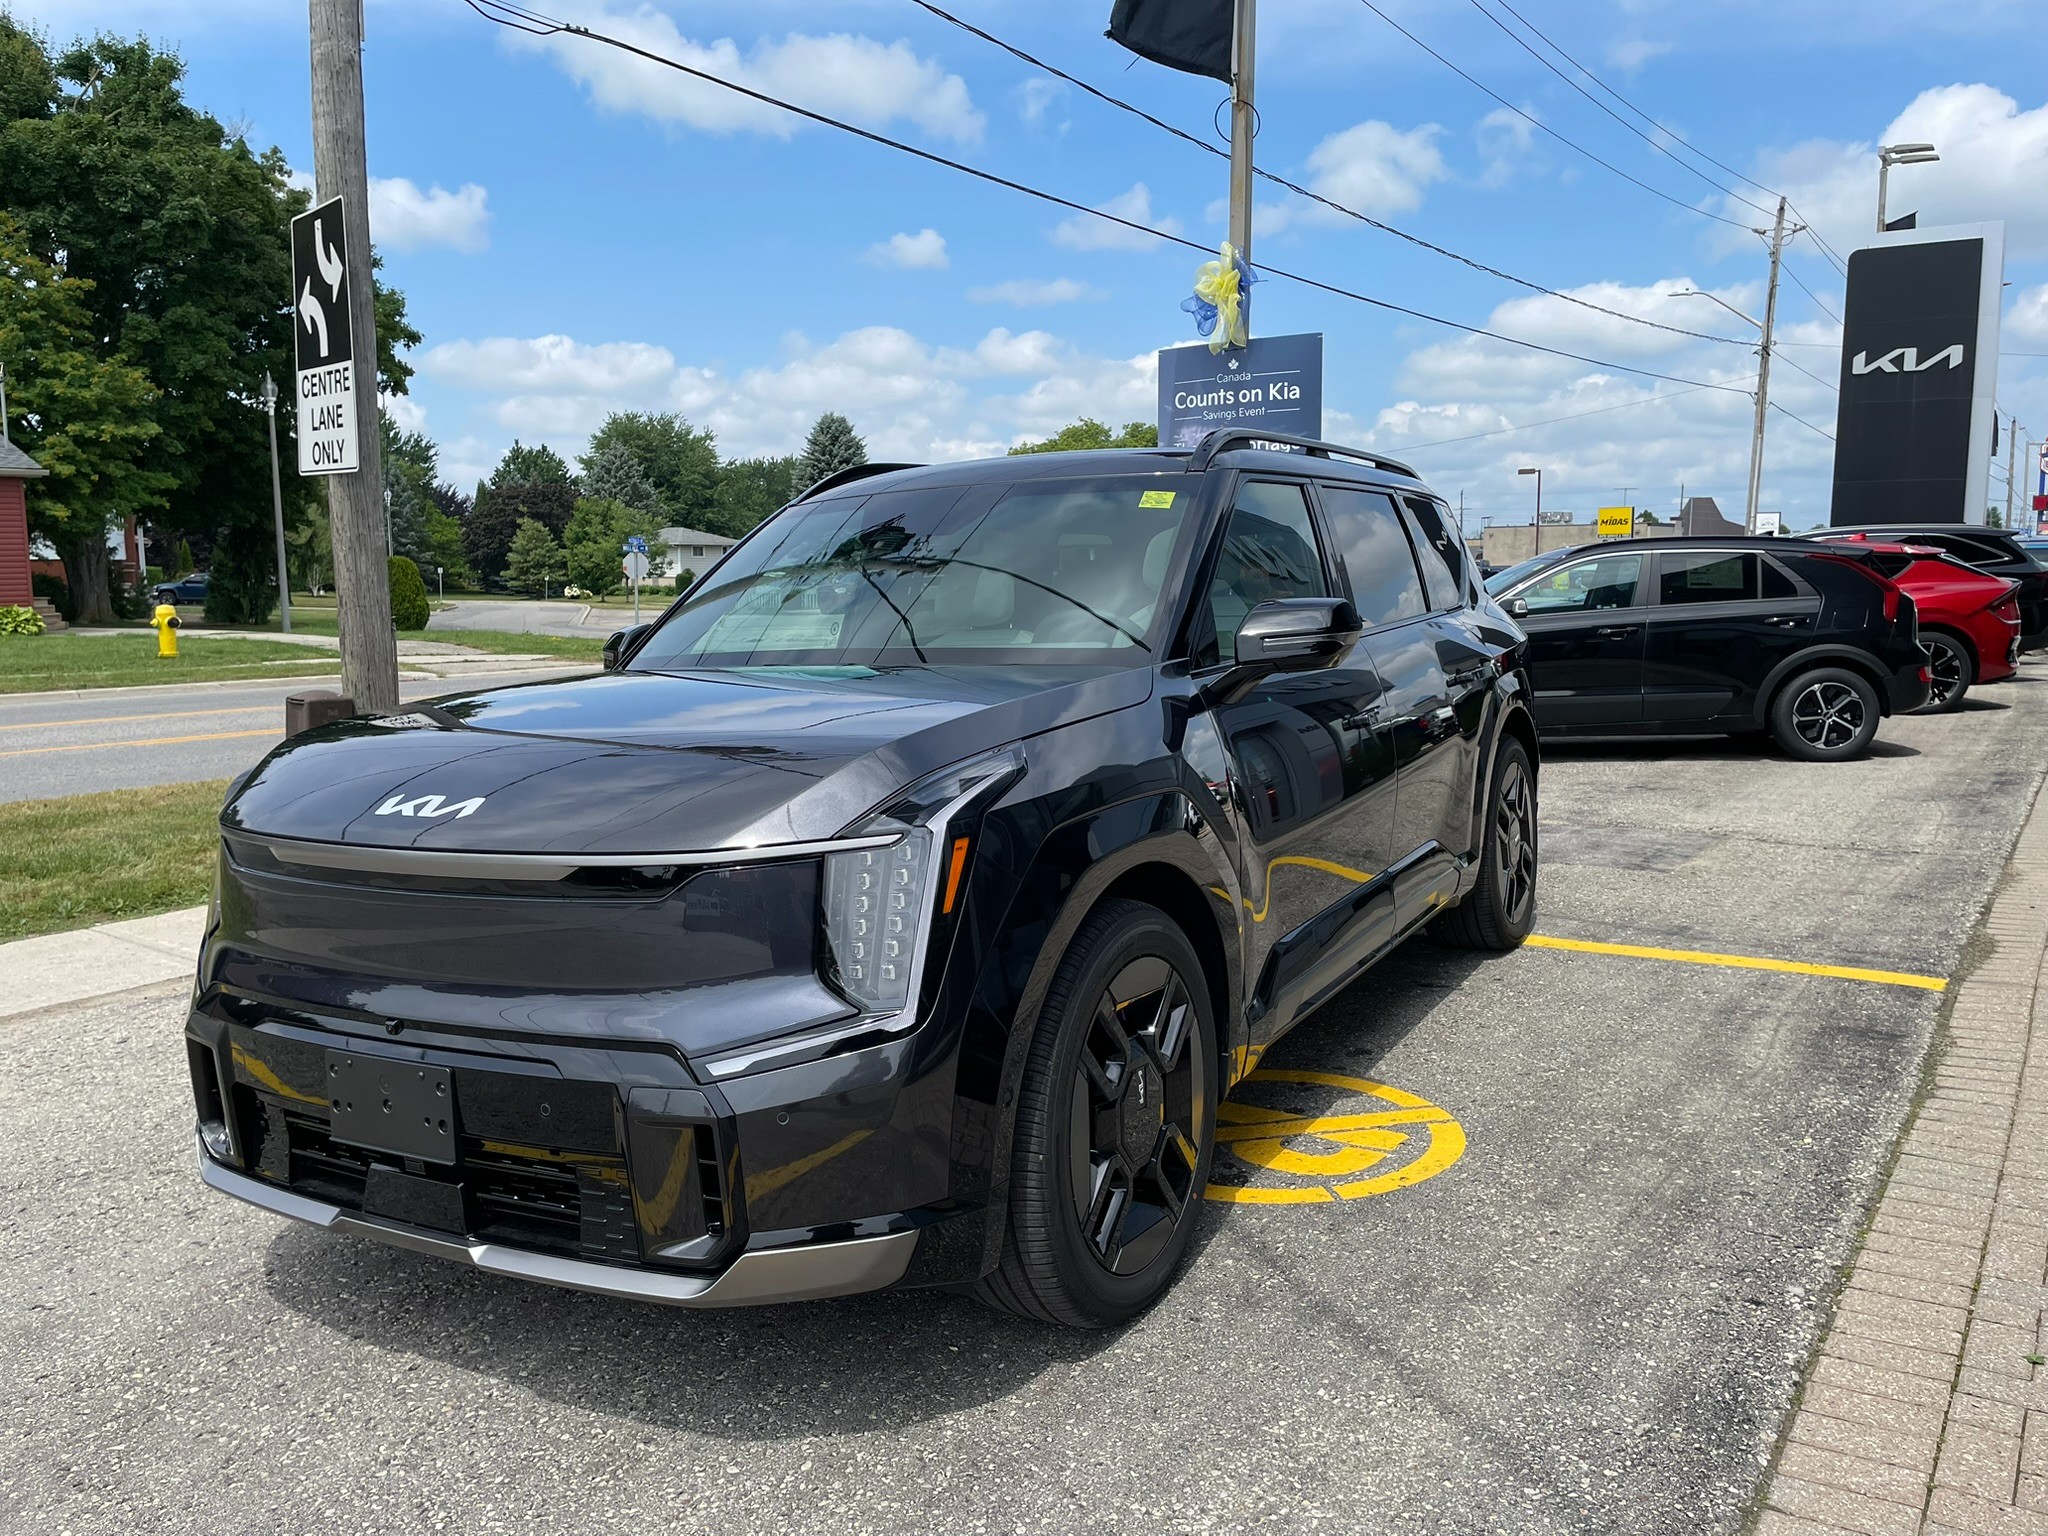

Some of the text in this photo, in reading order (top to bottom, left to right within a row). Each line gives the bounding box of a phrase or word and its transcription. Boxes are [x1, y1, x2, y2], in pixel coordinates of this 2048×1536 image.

[301, 366, 350, 399] CENTRE
[1216, 371, 1251, 384] Canada
[1174, 381, 1301, 409] Counts on Kia
[311, 404, 344, 432] LANE
[1202, 406, 1266, 421] Savings Event
[312, 439, 345, 466] ONLY
